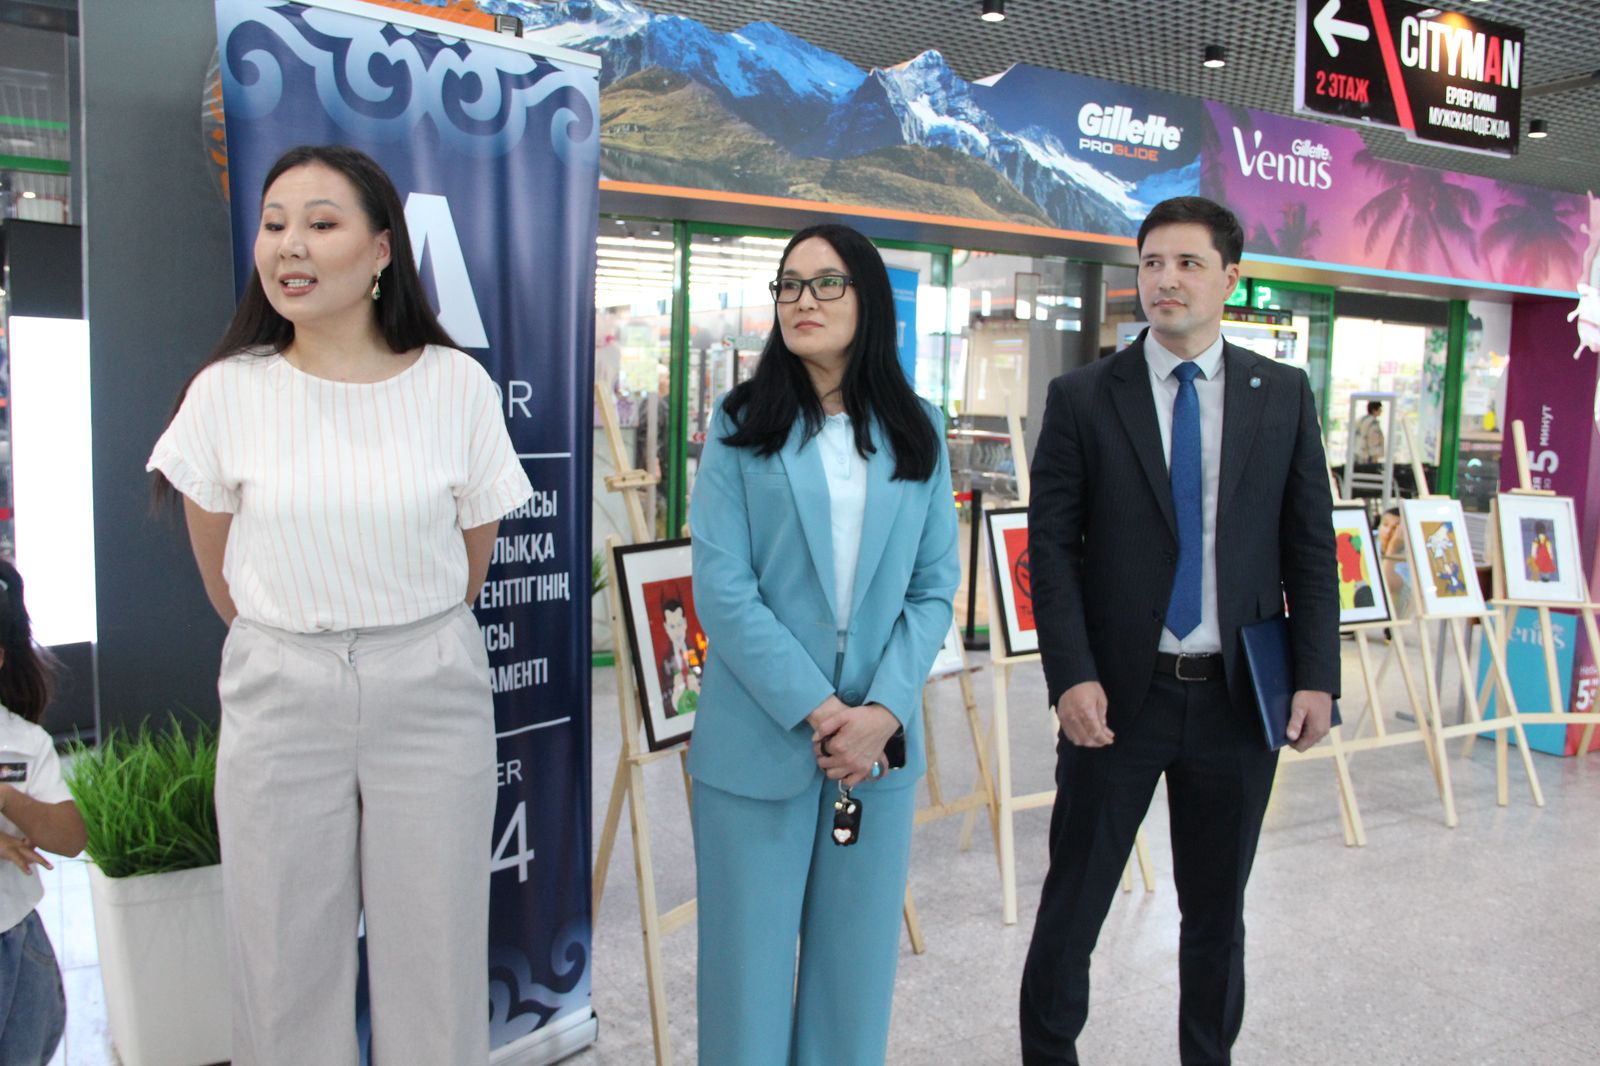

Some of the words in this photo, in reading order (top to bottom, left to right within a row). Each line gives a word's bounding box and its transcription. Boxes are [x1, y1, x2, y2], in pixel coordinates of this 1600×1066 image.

[1401, 16, 1520, 89] CITYMAN
[1316, 70, 1326, 95] 2
[1329, 72, 1370, 103] ЭТАЖ
[1446, 86, 1473, 108] ЕРЛЕР
[1078, 103, 1183, 150] Gillette
[1429, 106, 1473, 132] МУЖСКАЯ
[1473, 115, 1511, 140] ОДЕЖДА
[1079, 138, 1159, 162] PROGLIDE
[1232, 126, 1333, 190] Venus
[1292, 139, 1332, 161] Gillette
